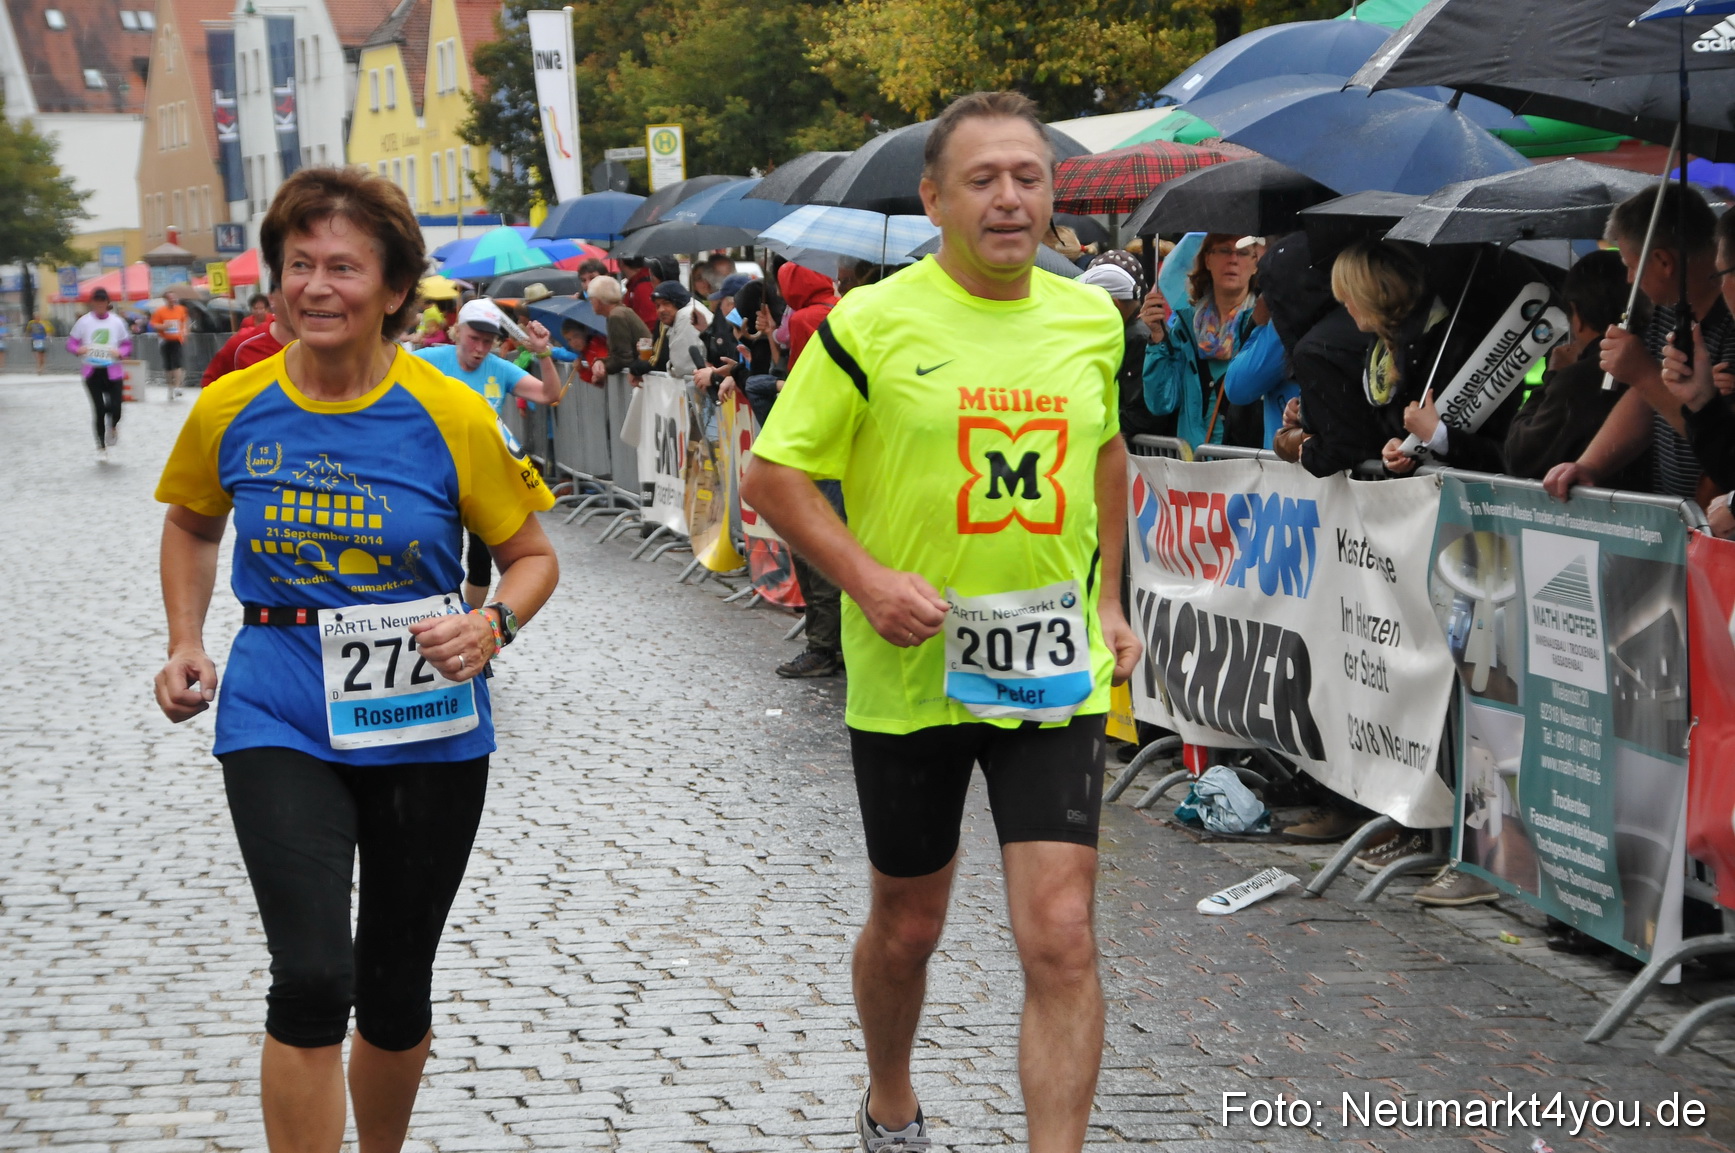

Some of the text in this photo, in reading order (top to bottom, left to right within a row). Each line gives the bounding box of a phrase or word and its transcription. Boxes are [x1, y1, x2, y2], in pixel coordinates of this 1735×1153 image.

[1441, 328, 1522, 424] bmw-laufspo
[957, 386, 1069, 413] Müller
[252, 457, 274, 467] Jahre
[259, 446, 269, 455] 15
[984, 450, 1042, 500] M
[353, 535, 383, 545] 2014
[993, 600, 1055, 620] Neumarkt
[324, 618, 377, 637] PARTL
[1561, 611, 1598, 640] HOFFER
[957, 617, 1075, 671] 2073
[1361, 650, 1389, 693] Stadt
[997, 684, 1045, 704] Peter
[354, 697, 458, 727] Rosemarie
[1552, 789, 1590, 818] Trockenbau
